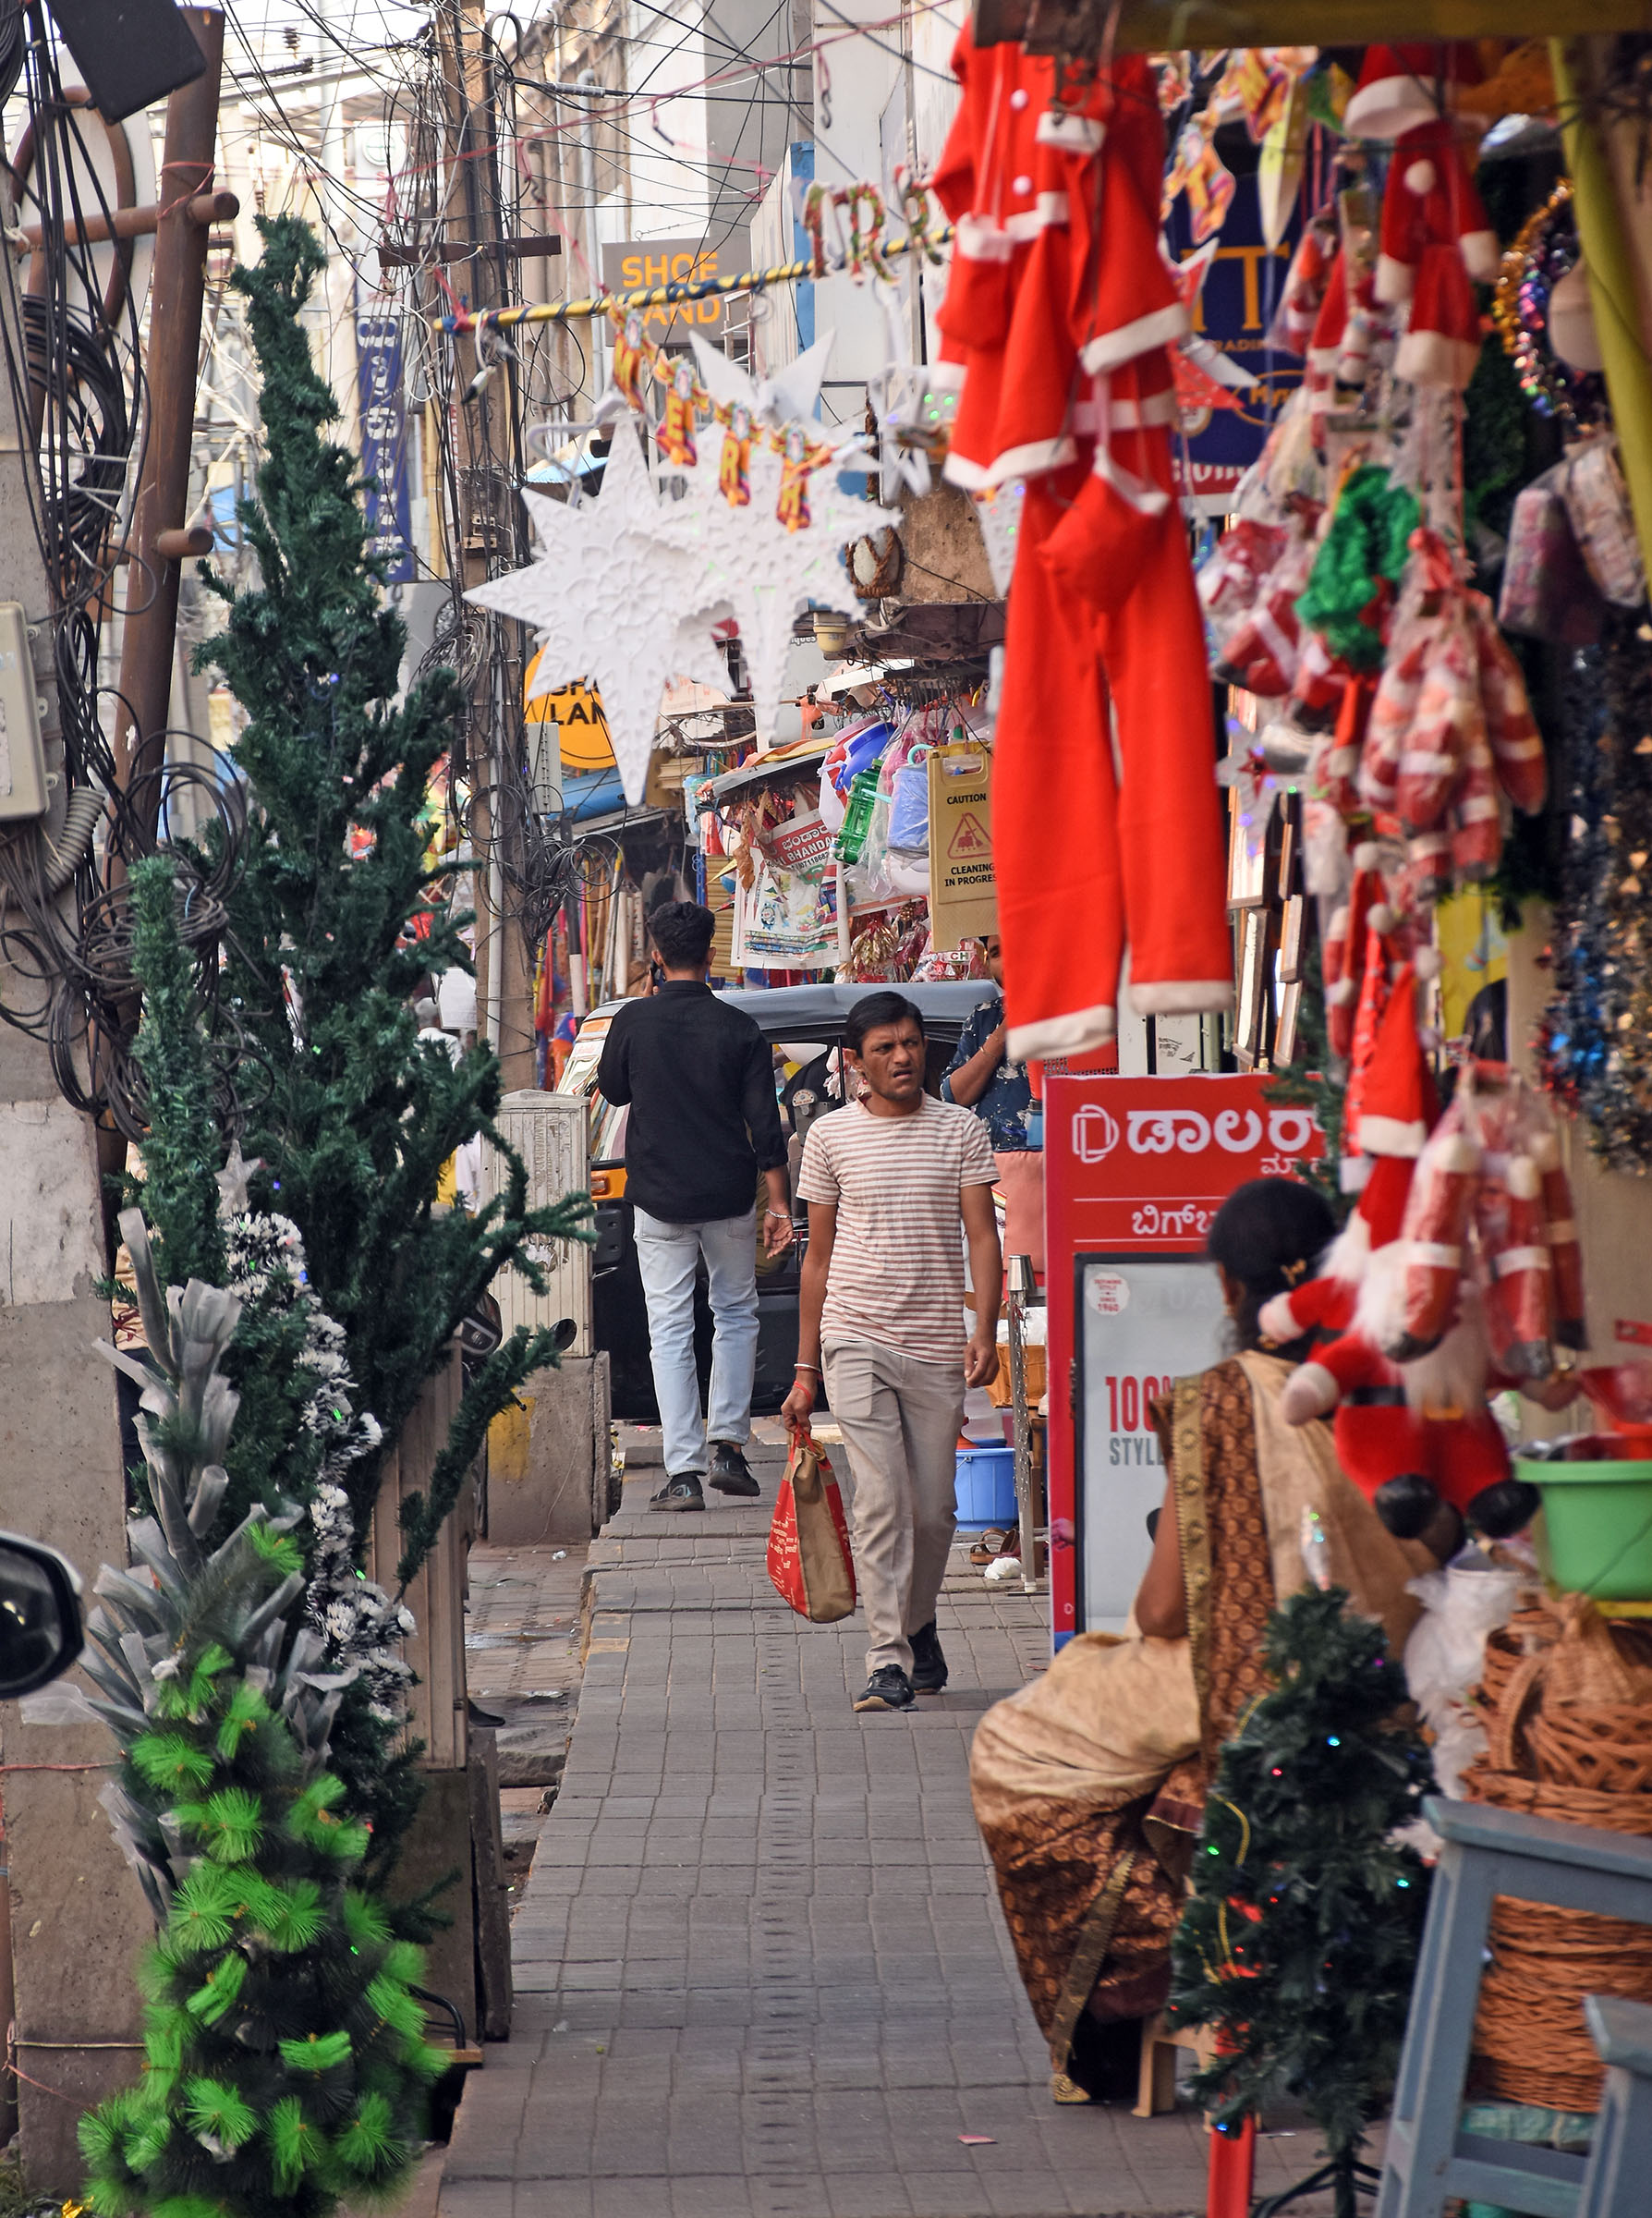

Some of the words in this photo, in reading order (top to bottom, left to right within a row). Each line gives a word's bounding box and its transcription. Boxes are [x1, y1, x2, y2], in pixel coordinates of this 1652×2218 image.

[621, 252, 718, 287] SHOE
[643, 298, 721, 326] AND
[550, 702, 608, 725] LAN
[946, 793, 987, 805] CAUTION
[787, 836, 832, 861] BHANDA
[951, 862, 996, 875] CLEANING
[944, 878, 955, 887] IN
[957, 874, 998, 886] PROGRES
